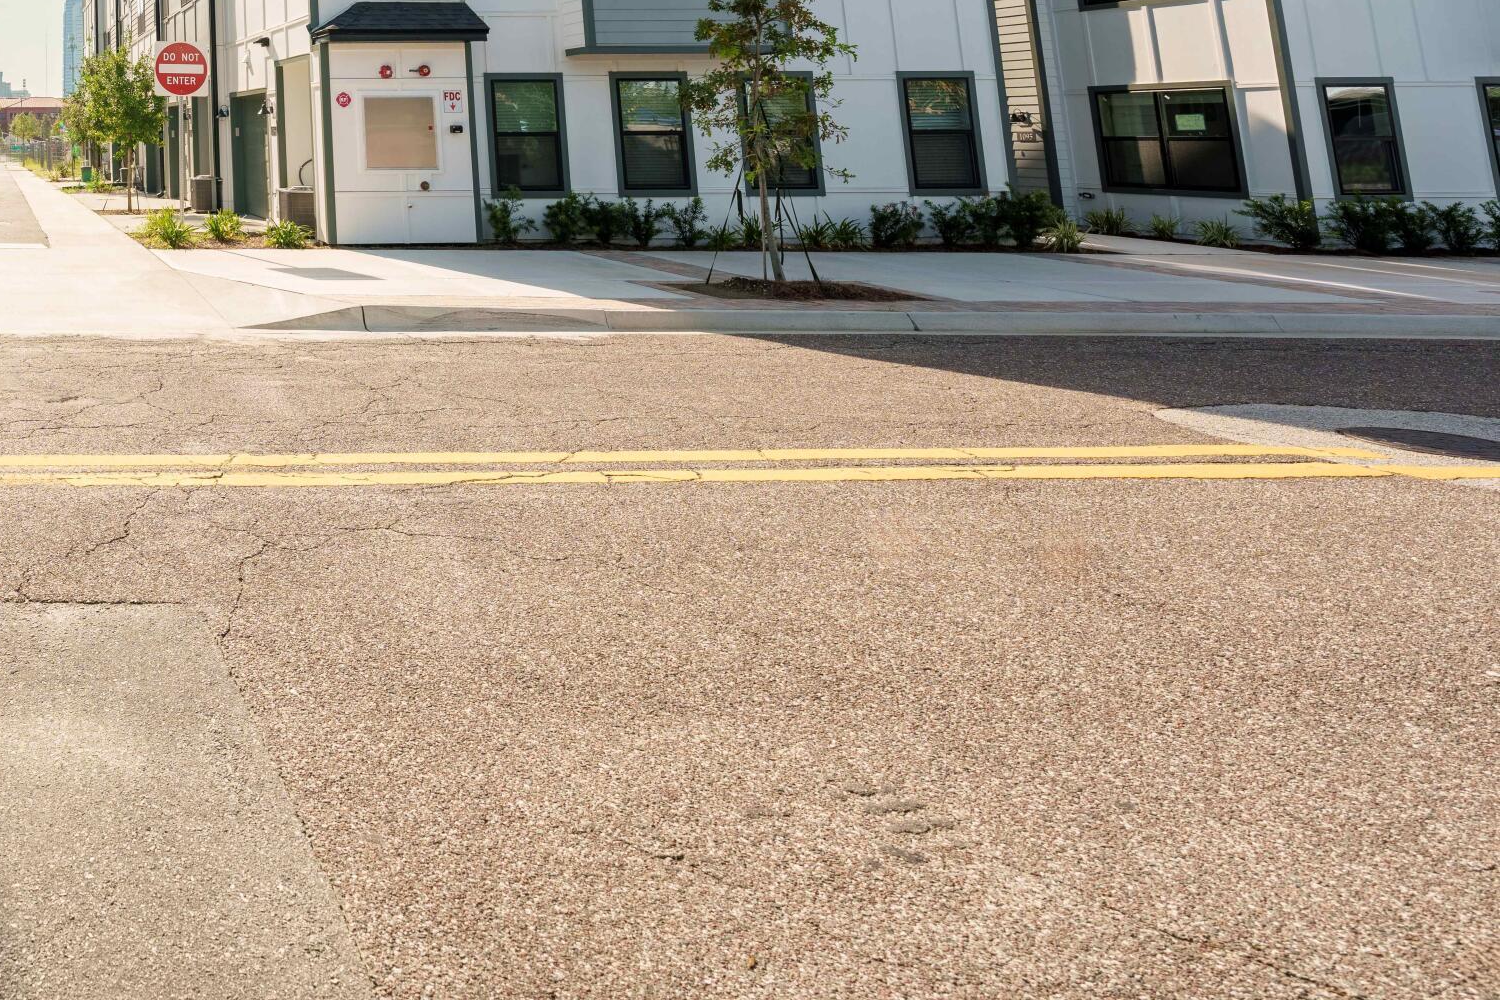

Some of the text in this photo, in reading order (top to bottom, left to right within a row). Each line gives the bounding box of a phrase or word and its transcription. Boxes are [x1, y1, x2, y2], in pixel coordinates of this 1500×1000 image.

[163, 53, 199, 62] DO NOT
[166, 76, 196, 85] ENTER
[444, 91, 461, 101] FDC
